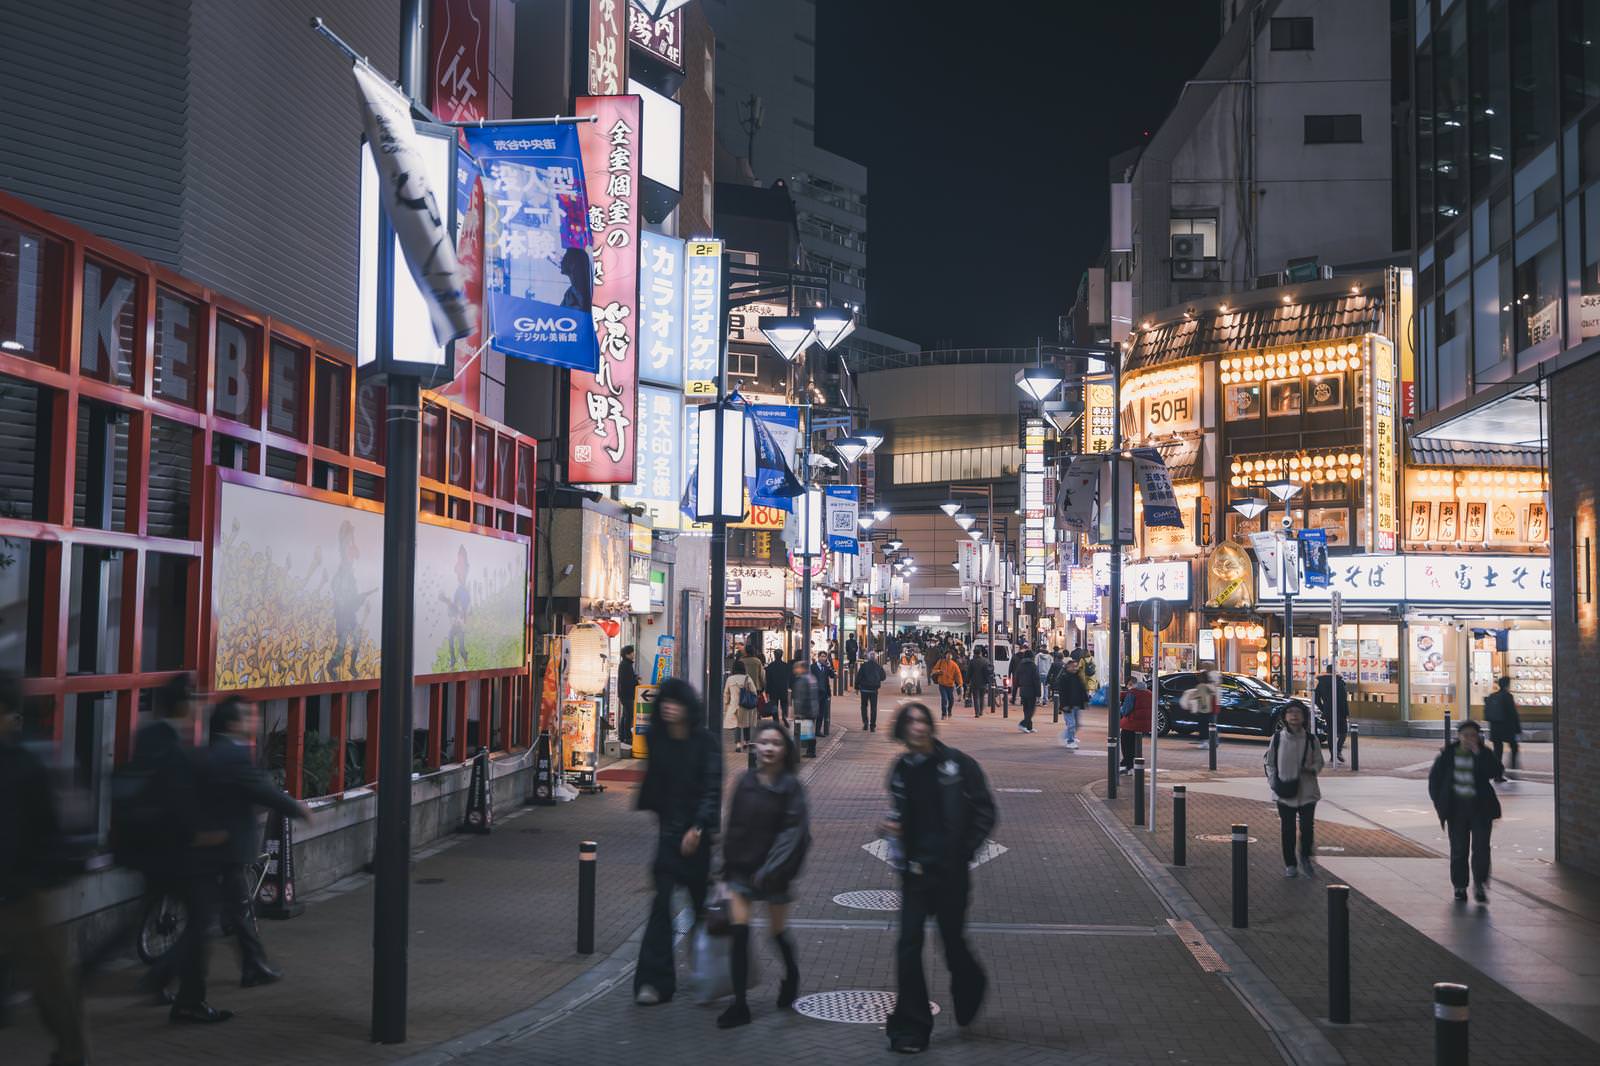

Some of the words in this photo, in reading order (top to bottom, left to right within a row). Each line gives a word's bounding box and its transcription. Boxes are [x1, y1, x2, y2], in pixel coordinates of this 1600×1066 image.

[607, 119, 632, 248] 全室個室の
[695, 244, 713, 256] 2F
[650, 246, 674, 369] カラオケ
[513, 317, 578, 332] GMO
[514, 332, 578, 343] デジタル美術館
[693, 382, 711, 393] 2F
[1150, 397, 1188, 425] 50円
